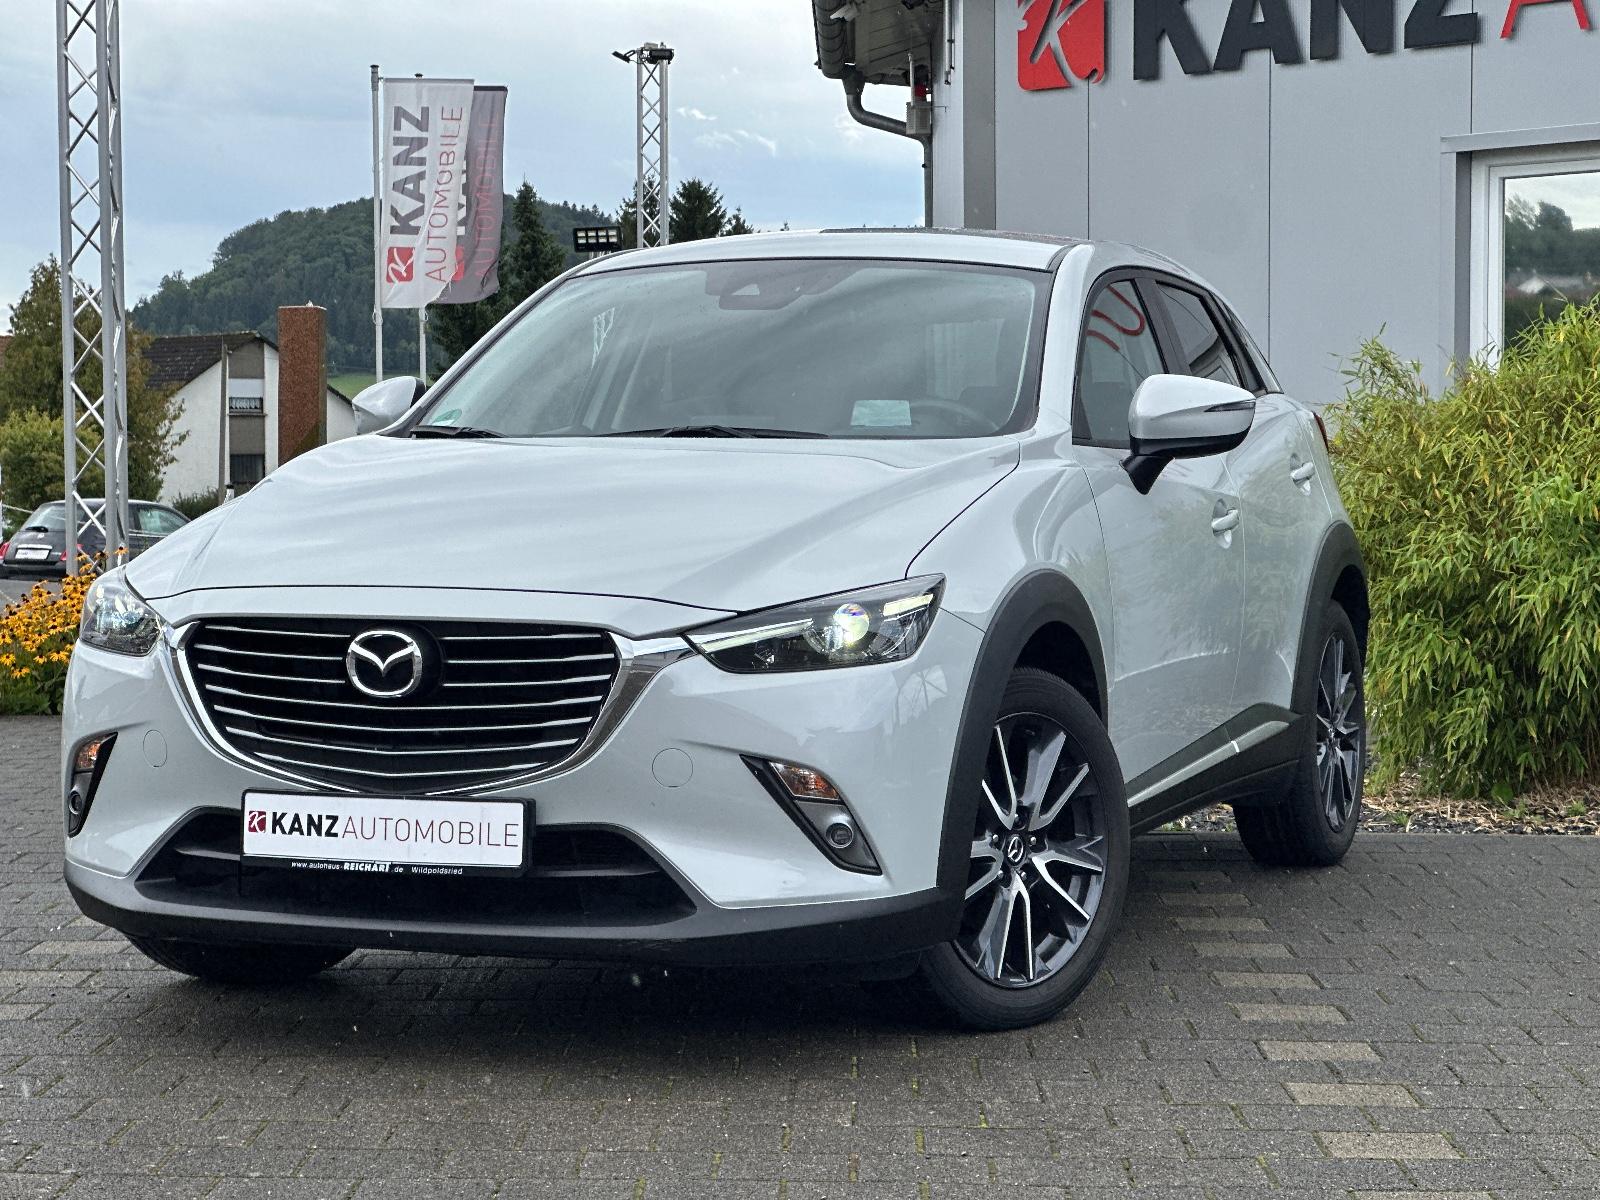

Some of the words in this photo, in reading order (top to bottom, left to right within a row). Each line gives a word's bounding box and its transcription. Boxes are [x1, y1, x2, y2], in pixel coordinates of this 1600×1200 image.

[390, 106, 430, 236] KANZ
[425, 105, 463, 283] AUTOMOBILE
[271, 811, 339, 838] KANZ
[342, 815, 519, 848] AUTOMOBILE
